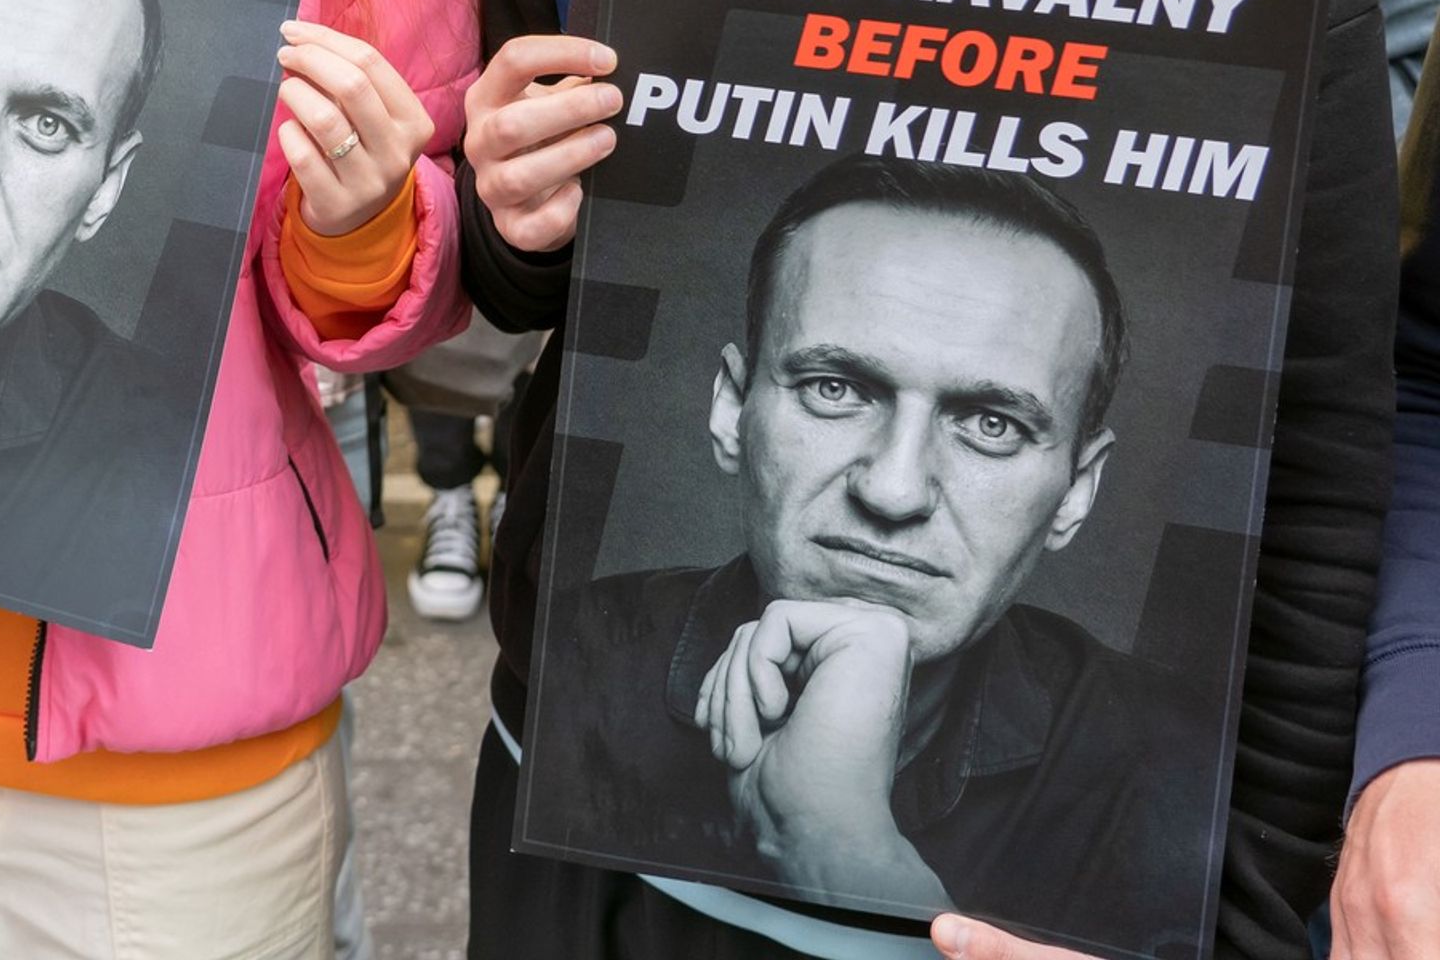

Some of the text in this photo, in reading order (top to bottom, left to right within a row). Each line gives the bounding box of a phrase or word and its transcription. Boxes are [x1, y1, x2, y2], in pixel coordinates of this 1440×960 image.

[794, 13, 1109, 100] BEFORE
[626, 73, 1270, 201] PUTIN KILLS HIM
